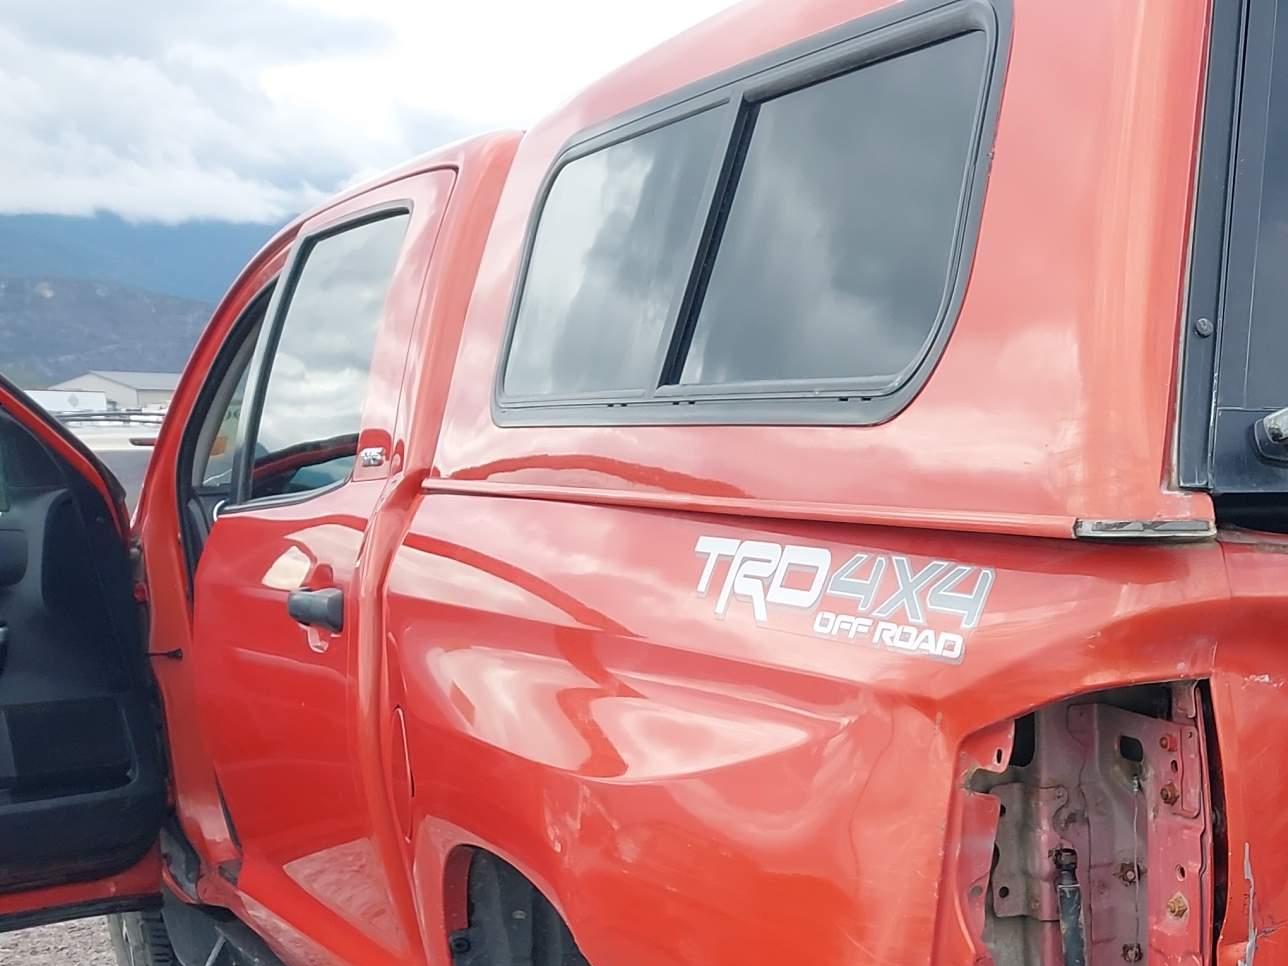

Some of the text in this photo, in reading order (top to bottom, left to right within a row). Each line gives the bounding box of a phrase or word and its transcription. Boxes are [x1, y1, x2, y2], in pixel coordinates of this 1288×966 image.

[694, 535, 998, 631] TRD 4X4
[813, 611, 967, 662] OFF ROAD
